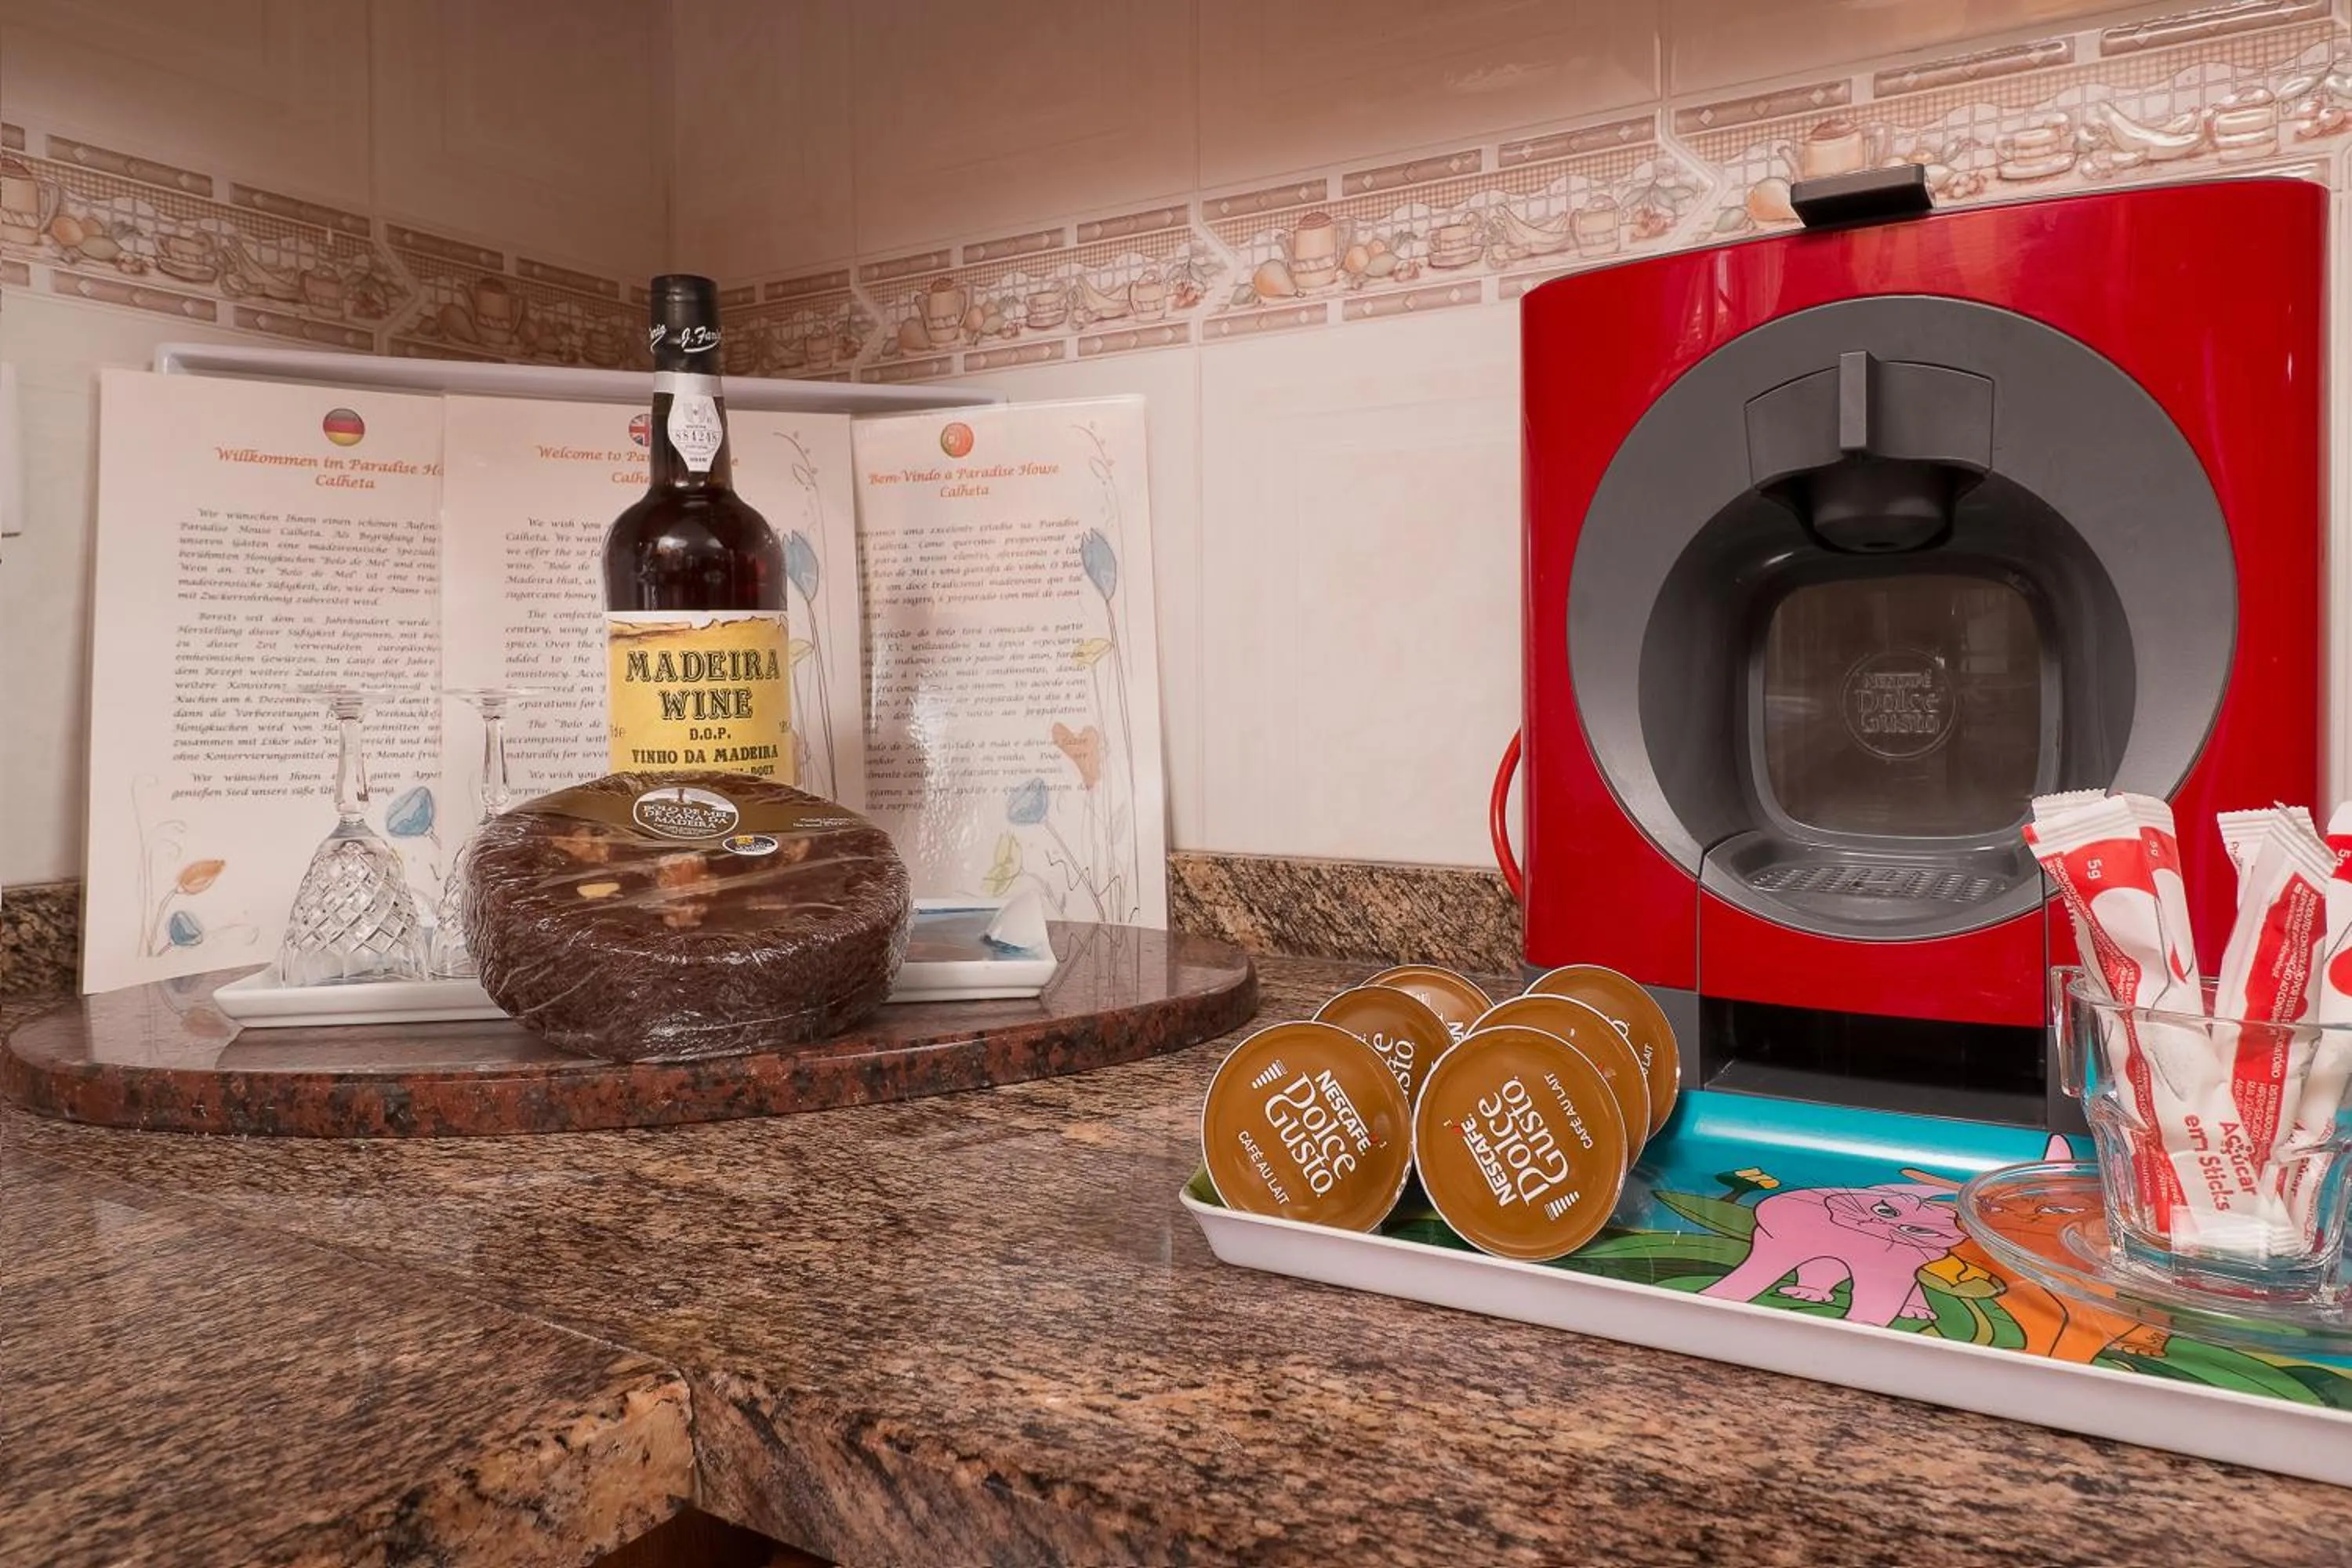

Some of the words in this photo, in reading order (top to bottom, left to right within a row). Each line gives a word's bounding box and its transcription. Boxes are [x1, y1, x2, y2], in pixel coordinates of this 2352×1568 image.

[216, 448, 318, 467] Willkommen
[323, 458, 344, 469] im
[348, 459, 417, 475] Paradise
[535, 444, 603, 461] Welcome
[608, 452, 621, 461] to
[315, 474, 376, 489] Calheta
[612, 471, 649, 485] Calhe
[868, 470, 941, 485] Bem-Vindo
[957, 466, 1014, 480] Paradise
[1018, 463, 1059, 477] House
[939, 486, 989, 498] Calheta
[198, 508, 219, 517] Wir
[180, 522, 228, 532] Paradise
[528, 610, 547, 619] The
[626, 648, 782, 682] MADEIRA
[658, 686, 753, 720] WINE
[689, 727, 731, 740] D.O.P.
[632, 750, 678, 764] VINHO
[684, 749, 706, 764] DA
[713, 744, 779, 763] MADEIRA
[643, 804, 679, 813] BOLO
[655, 817, 717, 829] MADEIRA
[708, 815, 728, 824] DA
[2087, 858, 2103, 880] 5g
[1388, 1040, 1414, 1088] sto
[1543, 1073, 1566, 1100] LAIT
[1560, 1098, 1577, 1116] AU
[1283, 1072, 1356, 1180] Dolce
[1570, 1116, 1594, 1149] CAFÉ
[1478, 1091, 1551, 1207] Dolce
[2219, 1121, 2258, 1196] Açúcar
[1238, 1131, 1265, 1163] CAFÉ
[1257, 1161, 1274, 1180] AU
[1267, 1178, 1290, 1205] LAIT
[2183, 1114, 2209, 1152] em
[2198, 1155, 2234, 1212] Sticks
